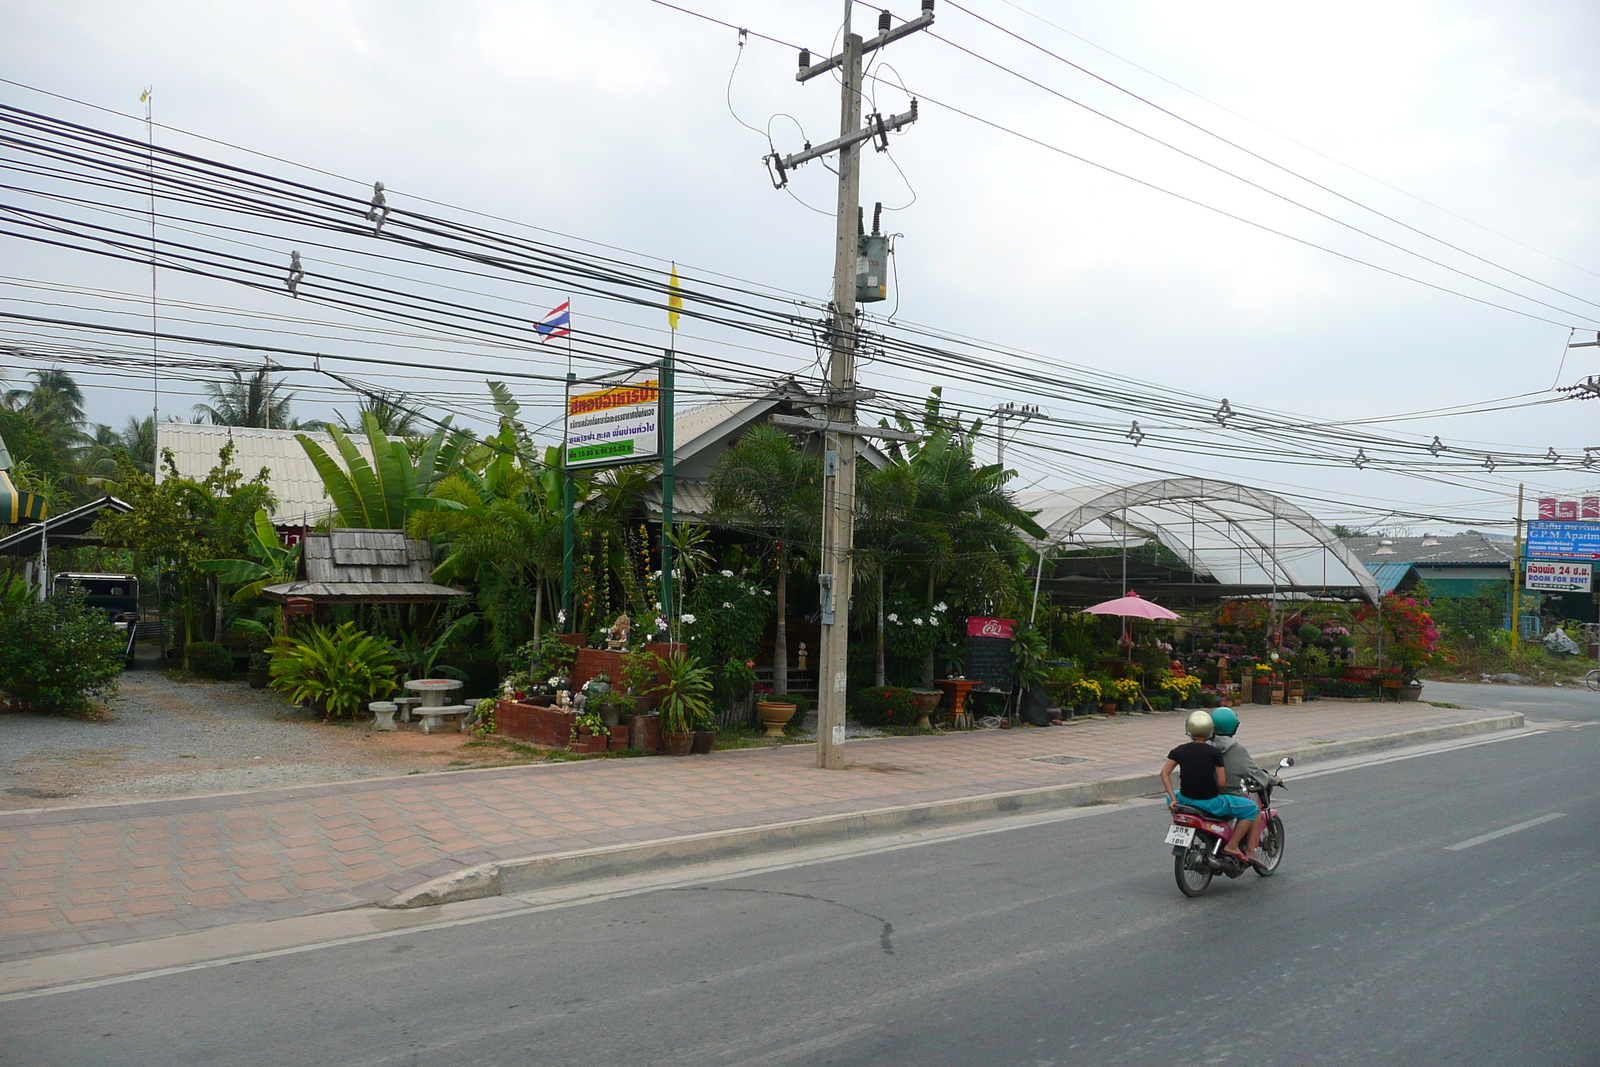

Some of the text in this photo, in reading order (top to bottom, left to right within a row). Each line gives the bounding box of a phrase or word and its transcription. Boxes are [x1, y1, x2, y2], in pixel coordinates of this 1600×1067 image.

[597, 431, 611, 440] ทะเล
[1528, 563, 1555, 574] ห้องพัก
[1558, 566, 1570, 575] 24
